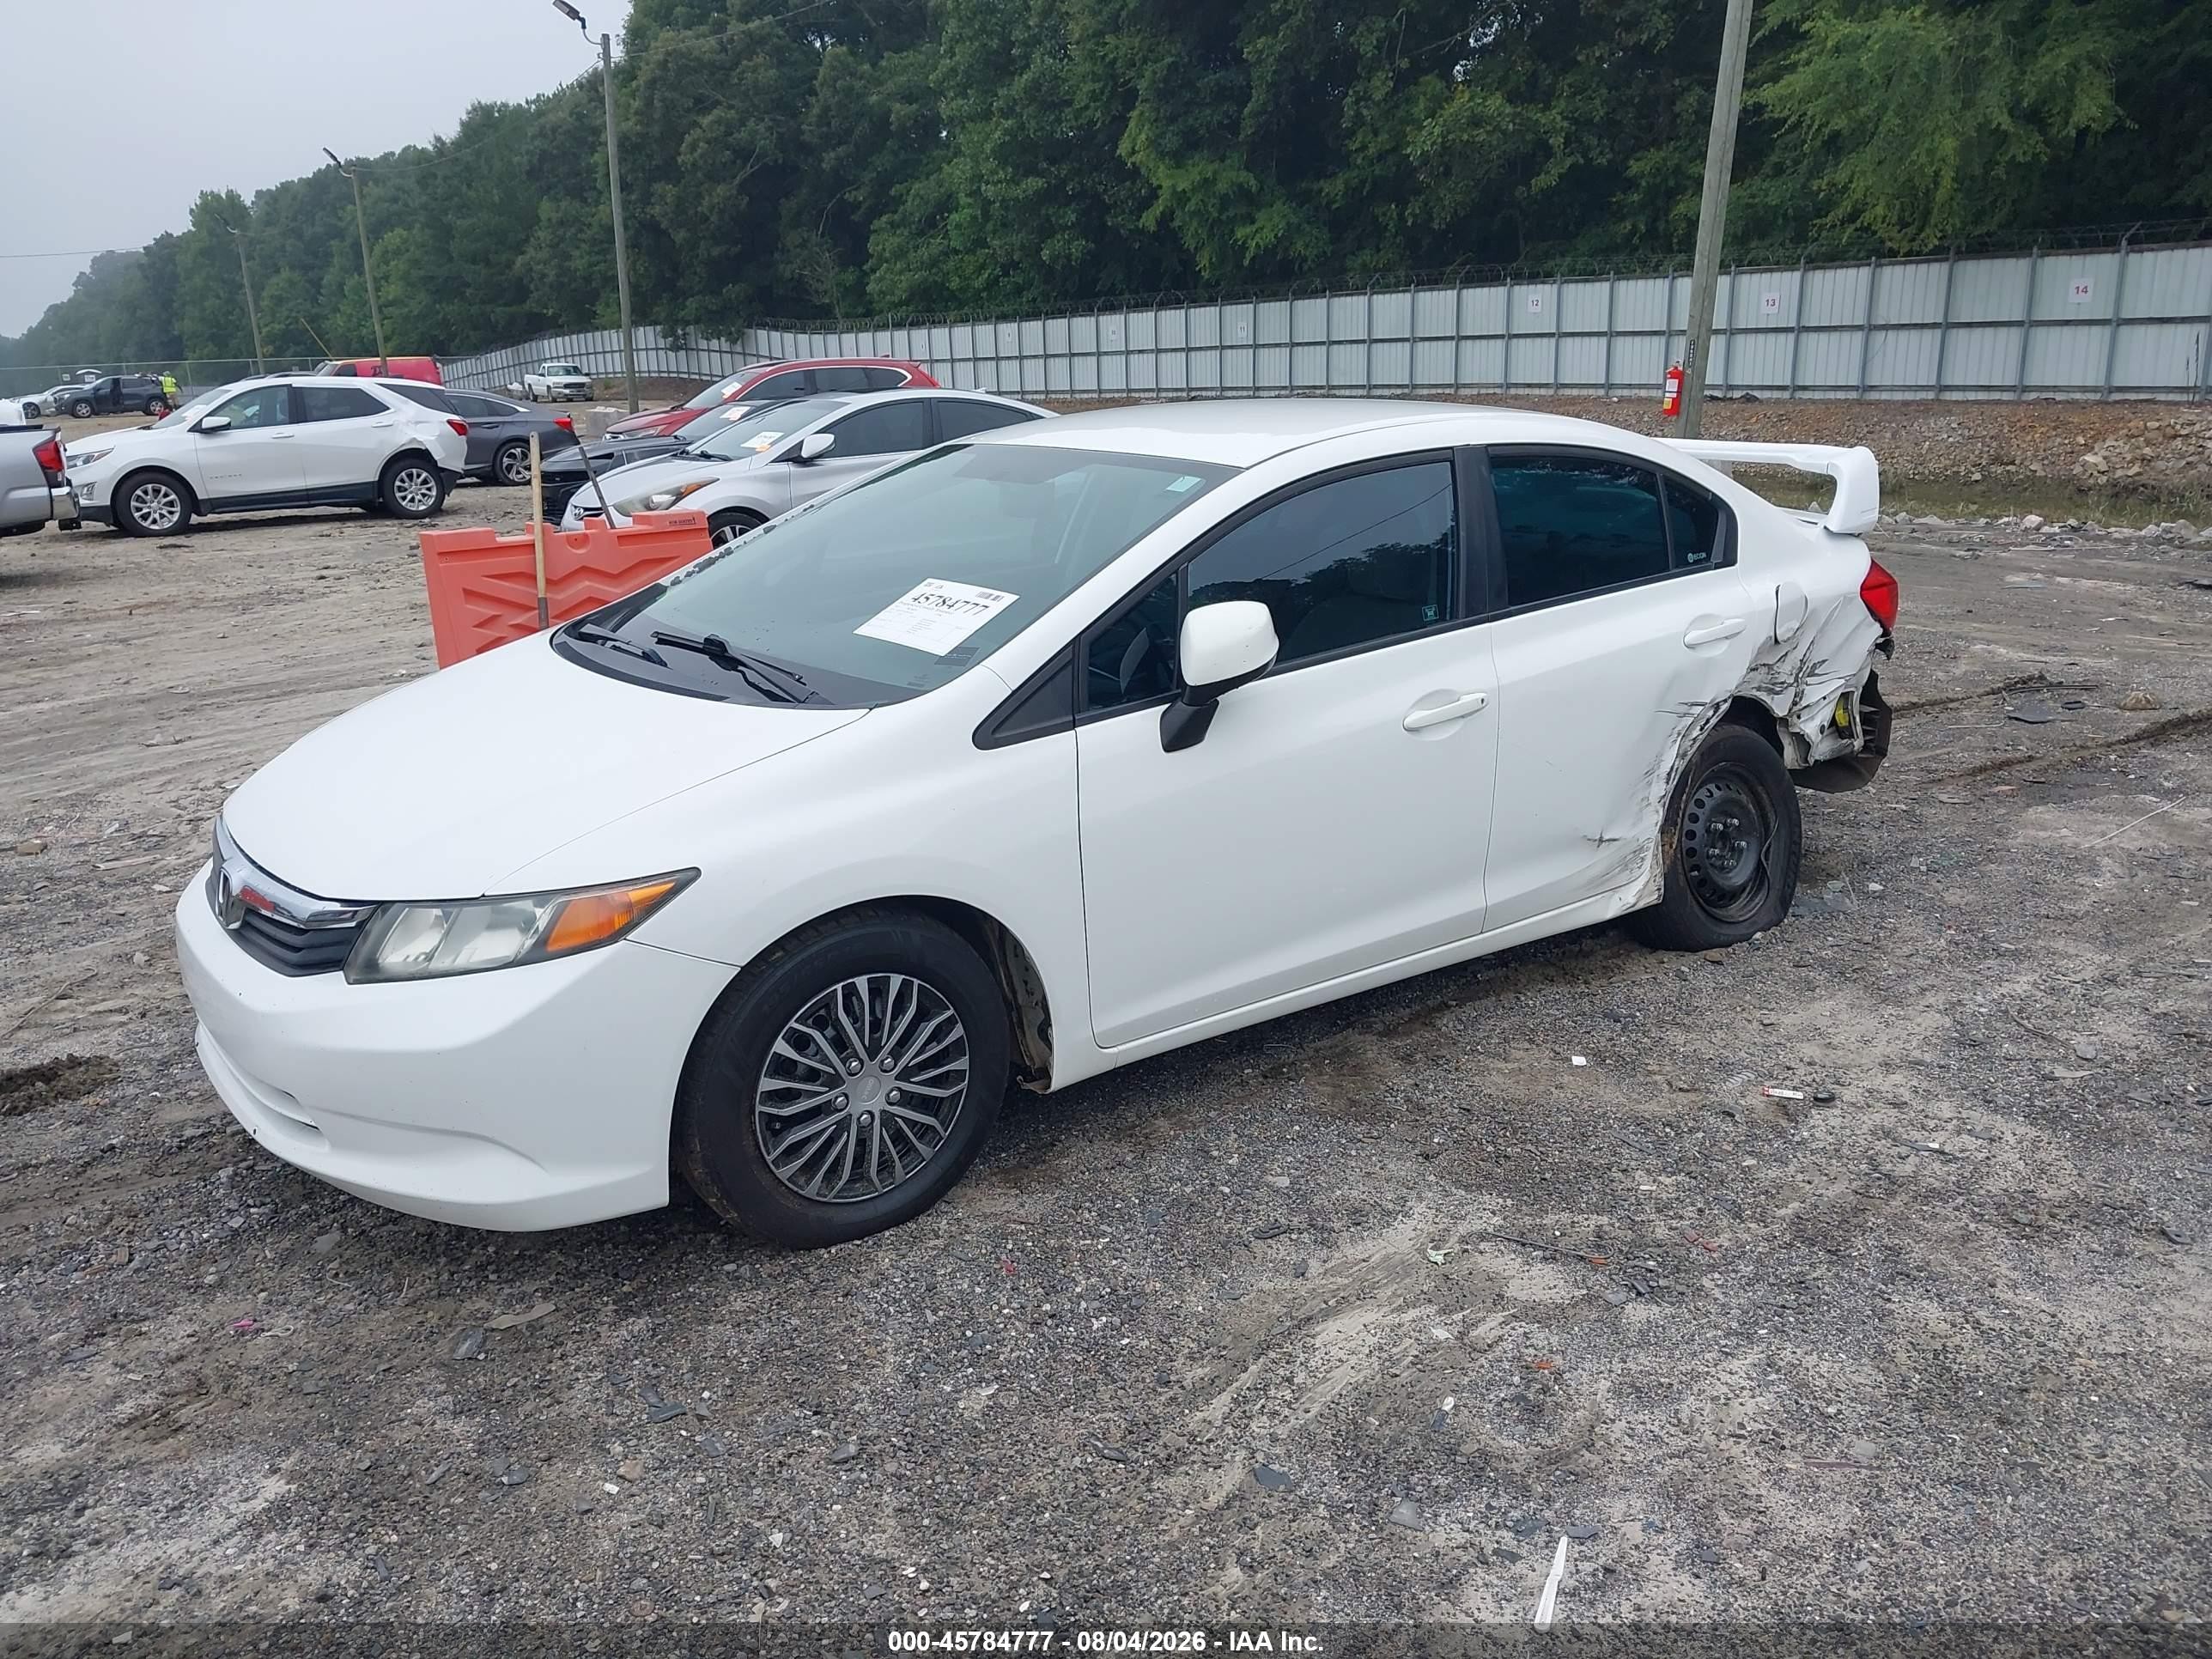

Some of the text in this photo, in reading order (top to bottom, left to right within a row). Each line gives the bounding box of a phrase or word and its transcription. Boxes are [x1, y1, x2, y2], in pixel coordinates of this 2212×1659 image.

[2075, 286, 2088, 295] 14
[1765, 298, 1776, 307] 13
[911, 592, 990, 616] 45784777
